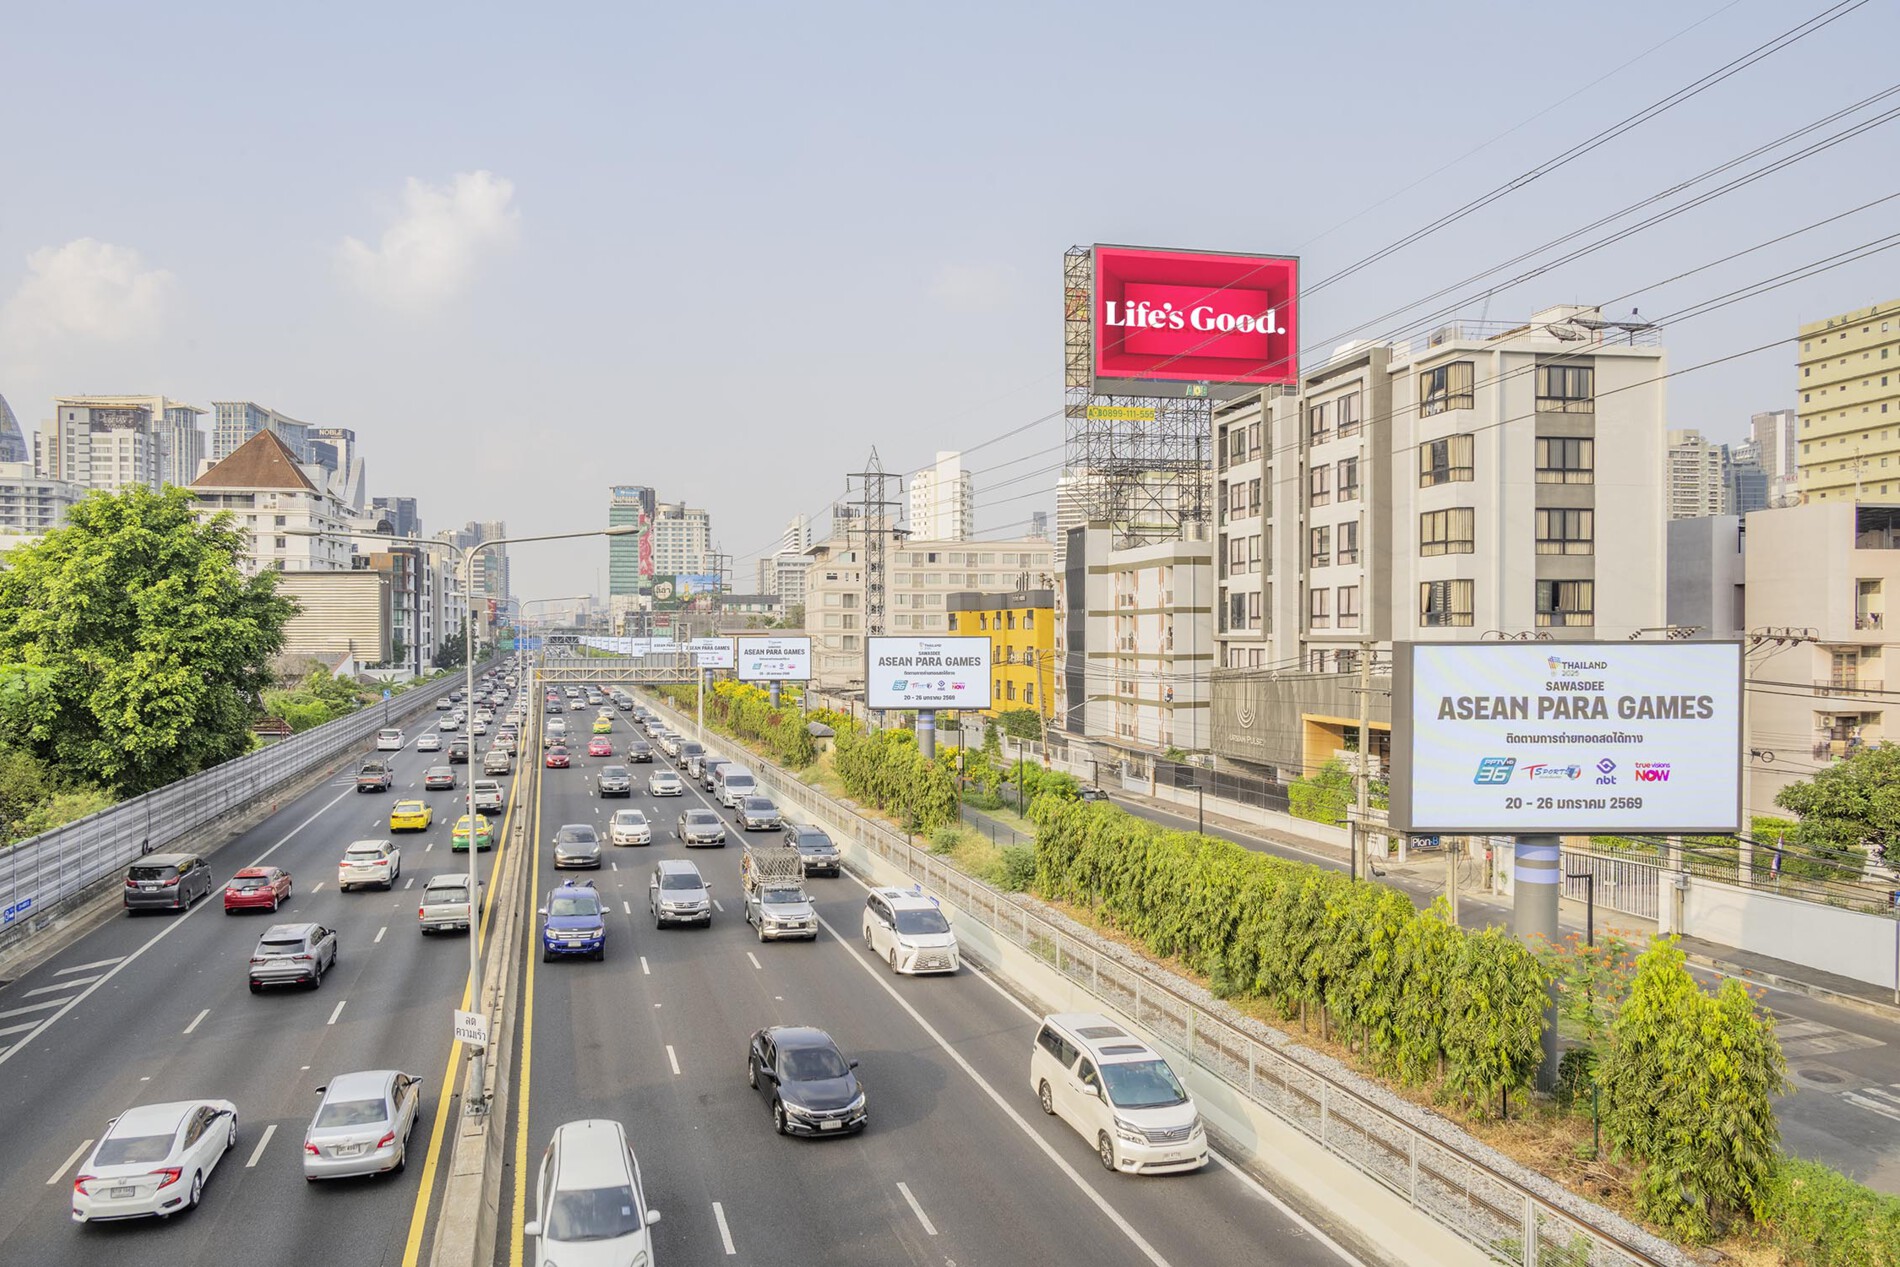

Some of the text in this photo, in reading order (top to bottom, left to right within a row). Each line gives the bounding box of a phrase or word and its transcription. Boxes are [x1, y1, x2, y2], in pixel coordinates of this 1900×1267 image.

[1105, 300, 1286, 335] Life's Good.
[878, 656, 981, 667] ASEAN PARA GAMES
[1562, 661, 1608, 670] THAILAND
[1546, 681, 1605, 692] SAWASDEE
[1437, 695, 1714, 720] ASEAN PARA GAMES
[1506, 731, 1644, 744] ติดตามการถ่ายทอดสดได้ทาง
[1477, 766, 1510, 782] 36
[1596, 775, 1617, 785] nbt
[1635, 769, 1671, 782] NOW
[1505, 797, 1522, 809] 20
[1536, 797, 1553, 809] 26
[1557, 798, 1606, 809] มกราคม
[1610, 796, 1643, 809] 2569
[465, 1016, 477, 1027] ลด
